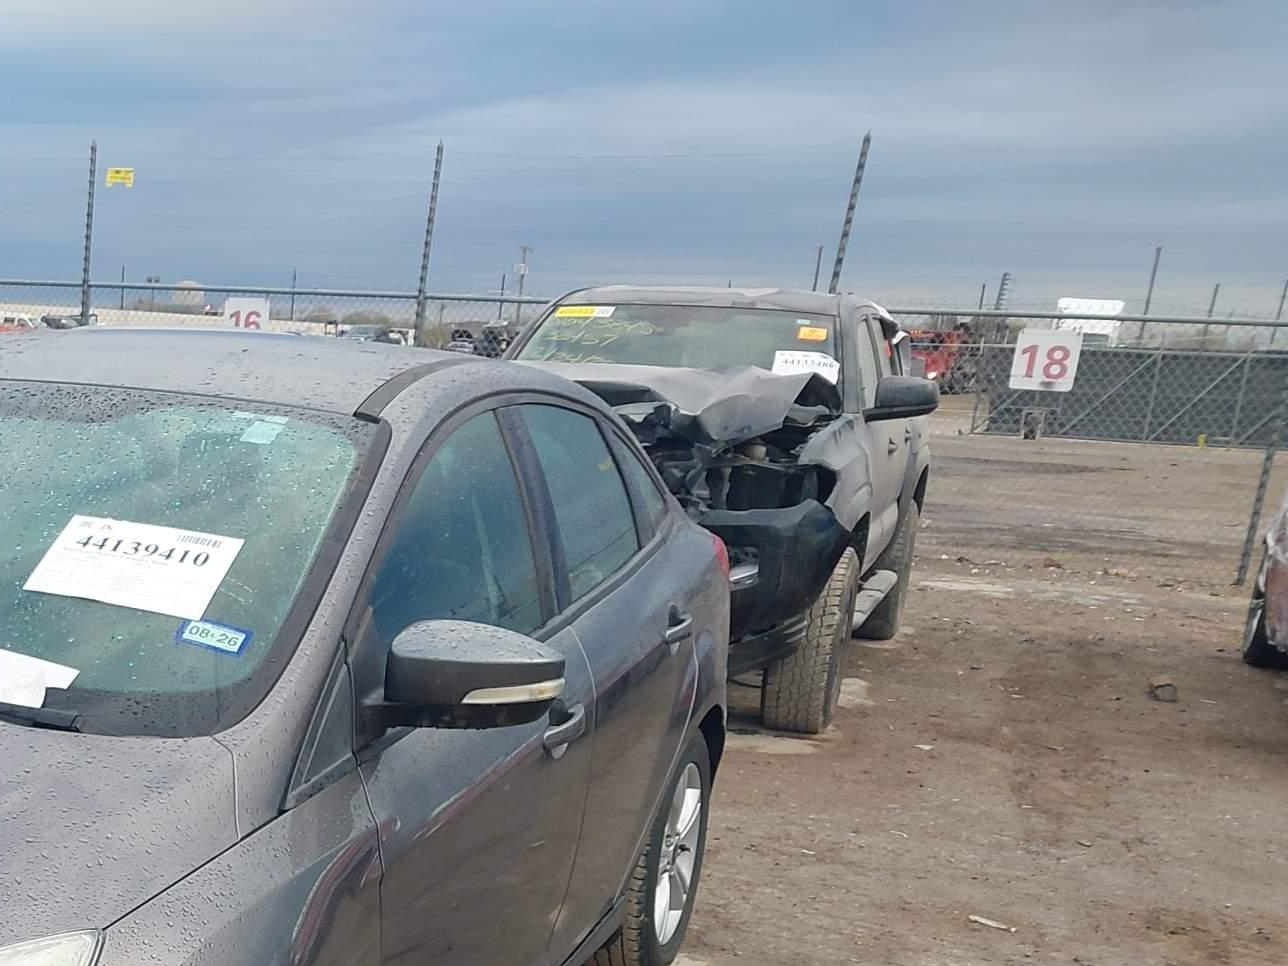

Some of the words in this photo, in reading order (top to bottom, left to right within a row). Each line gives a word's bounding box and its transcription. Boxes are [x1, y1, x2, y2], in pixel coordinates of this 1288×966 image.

[229, 310, 260, 329] 16
[1021, 344, 1071, 380] 18
[76, 535, 211, 567] 44139410
